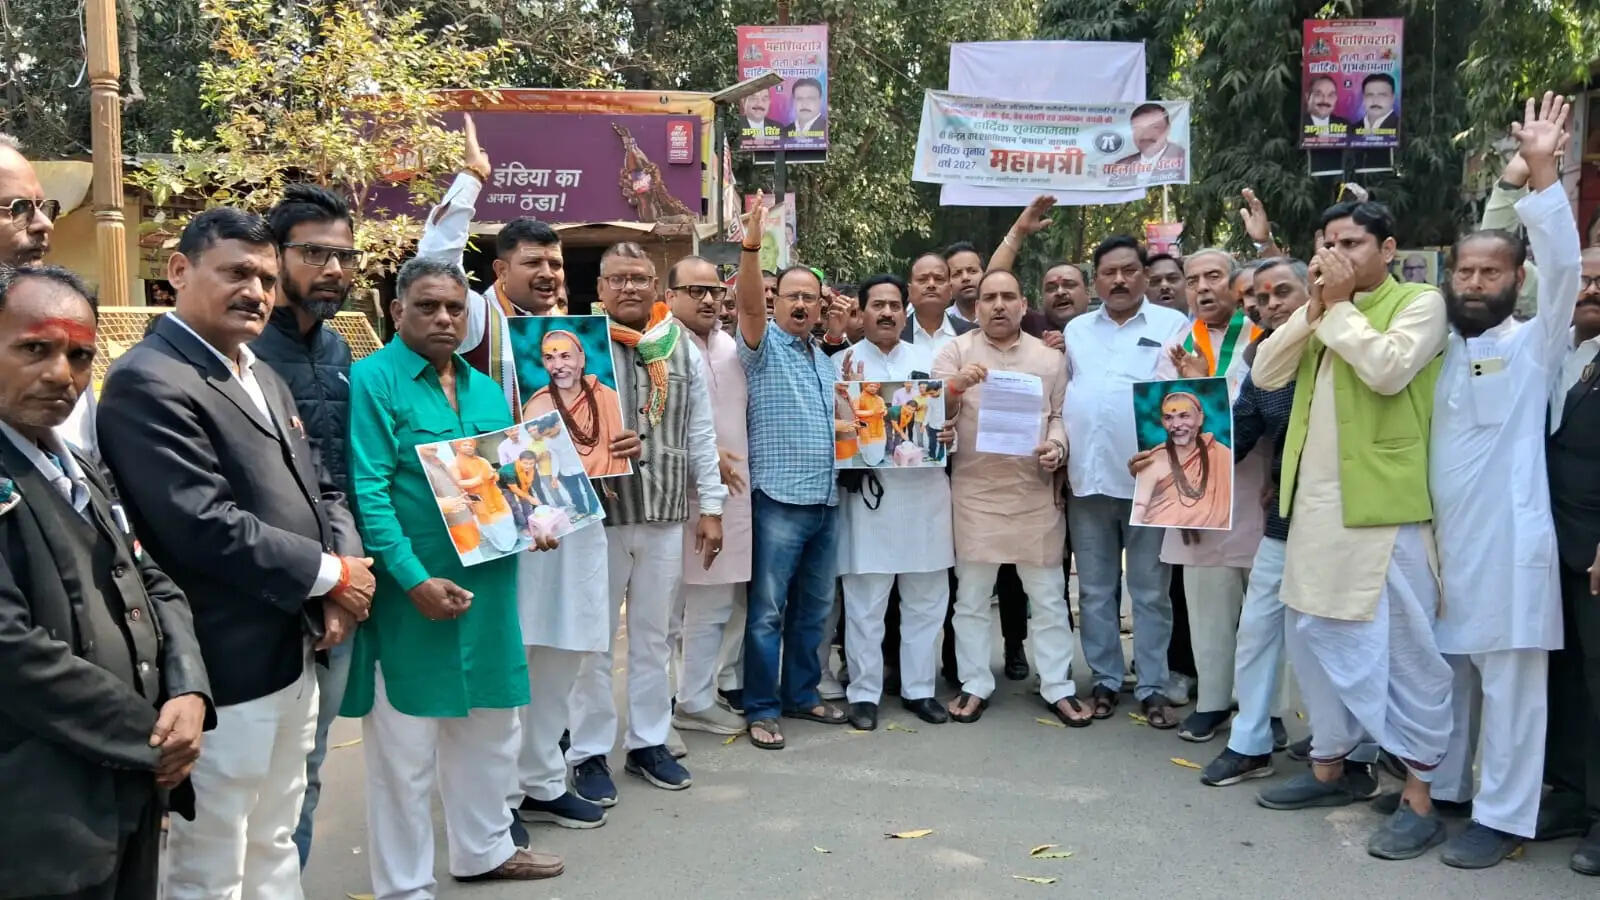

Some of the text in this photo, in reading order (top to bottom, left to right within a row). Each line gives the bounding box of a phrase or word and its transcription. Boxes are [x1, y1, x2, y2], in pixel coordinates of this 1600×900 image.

[973, 120, 1009, 133] हार्दिक
[962, 147, 986, 158] चुनाव
[990, 146, 1087, 175] महामंत्री
[953, 160, 977, 169] 2027
[493, 161, 583, 189] इंडिया का
[487, 188, 566, 213] अपना ठंडा!
